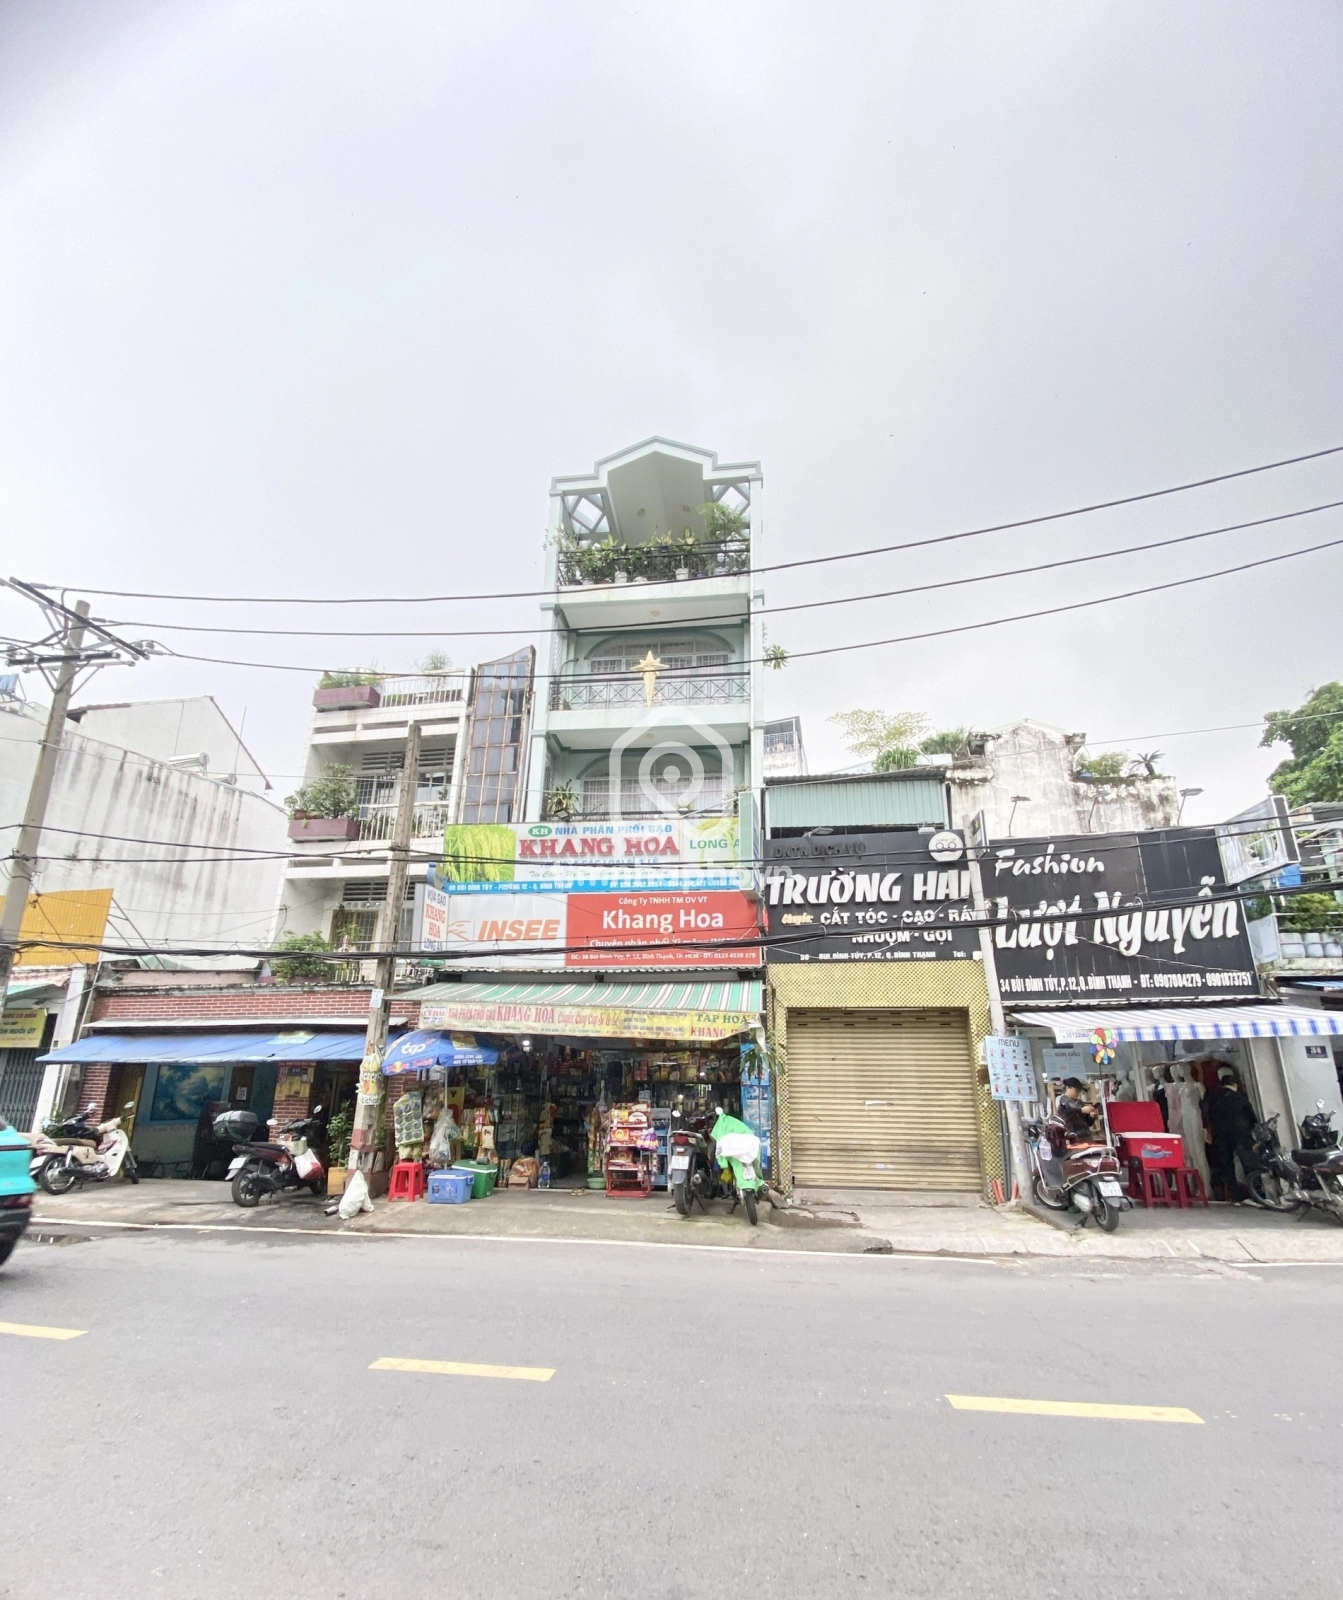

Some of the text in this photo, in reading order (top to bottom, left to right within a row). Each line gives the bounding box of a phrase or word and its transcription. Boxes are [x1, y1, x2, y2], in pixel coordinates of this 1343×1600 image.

[531, 827, 549, 835] KH
[519, 836, 680, 858] KHANG HOA
[689, 839, 728, 850] LONG
[995, 843, 1105, 877] Fashion
[766, 867, 903, 906] TRƯỜNG
[618, 897, 638, 907] Công
[639, 897, 648, 907] Ty
[649, 897, 671, 905] TNHH
[685, 896, 697, 904] DV
[698, 896, 708, 904] VT
[425, 904, 446, 924] KHANG
[602, 909, 724, 934] Khang Hoa
[820, 906, 851, 925] CẮT
[855, 907, 888, 924] TÓC
[902, 909, 936, 926] CẠO
[1093, 875, 1240, 957] Nguyễn
[428, 921, 441, 939] HOA
[478, 919, 561, 942] INSEE
[713, 952, 729, 960] 0123
[1000, 979, 1010, 992] 34
[1012, 976, 1025, 991] BÙI
[1025, 976, 1044, 991] ĐÌNH
[496, 1005, 532, 1022] KHANG
[534, 1006, 555, 1024] HOA
[690, 1026, 726, 1039] KHANG
[998, 1038, 1020, 1048] MENU
[1310, 1046, 1322, 1054] 34
